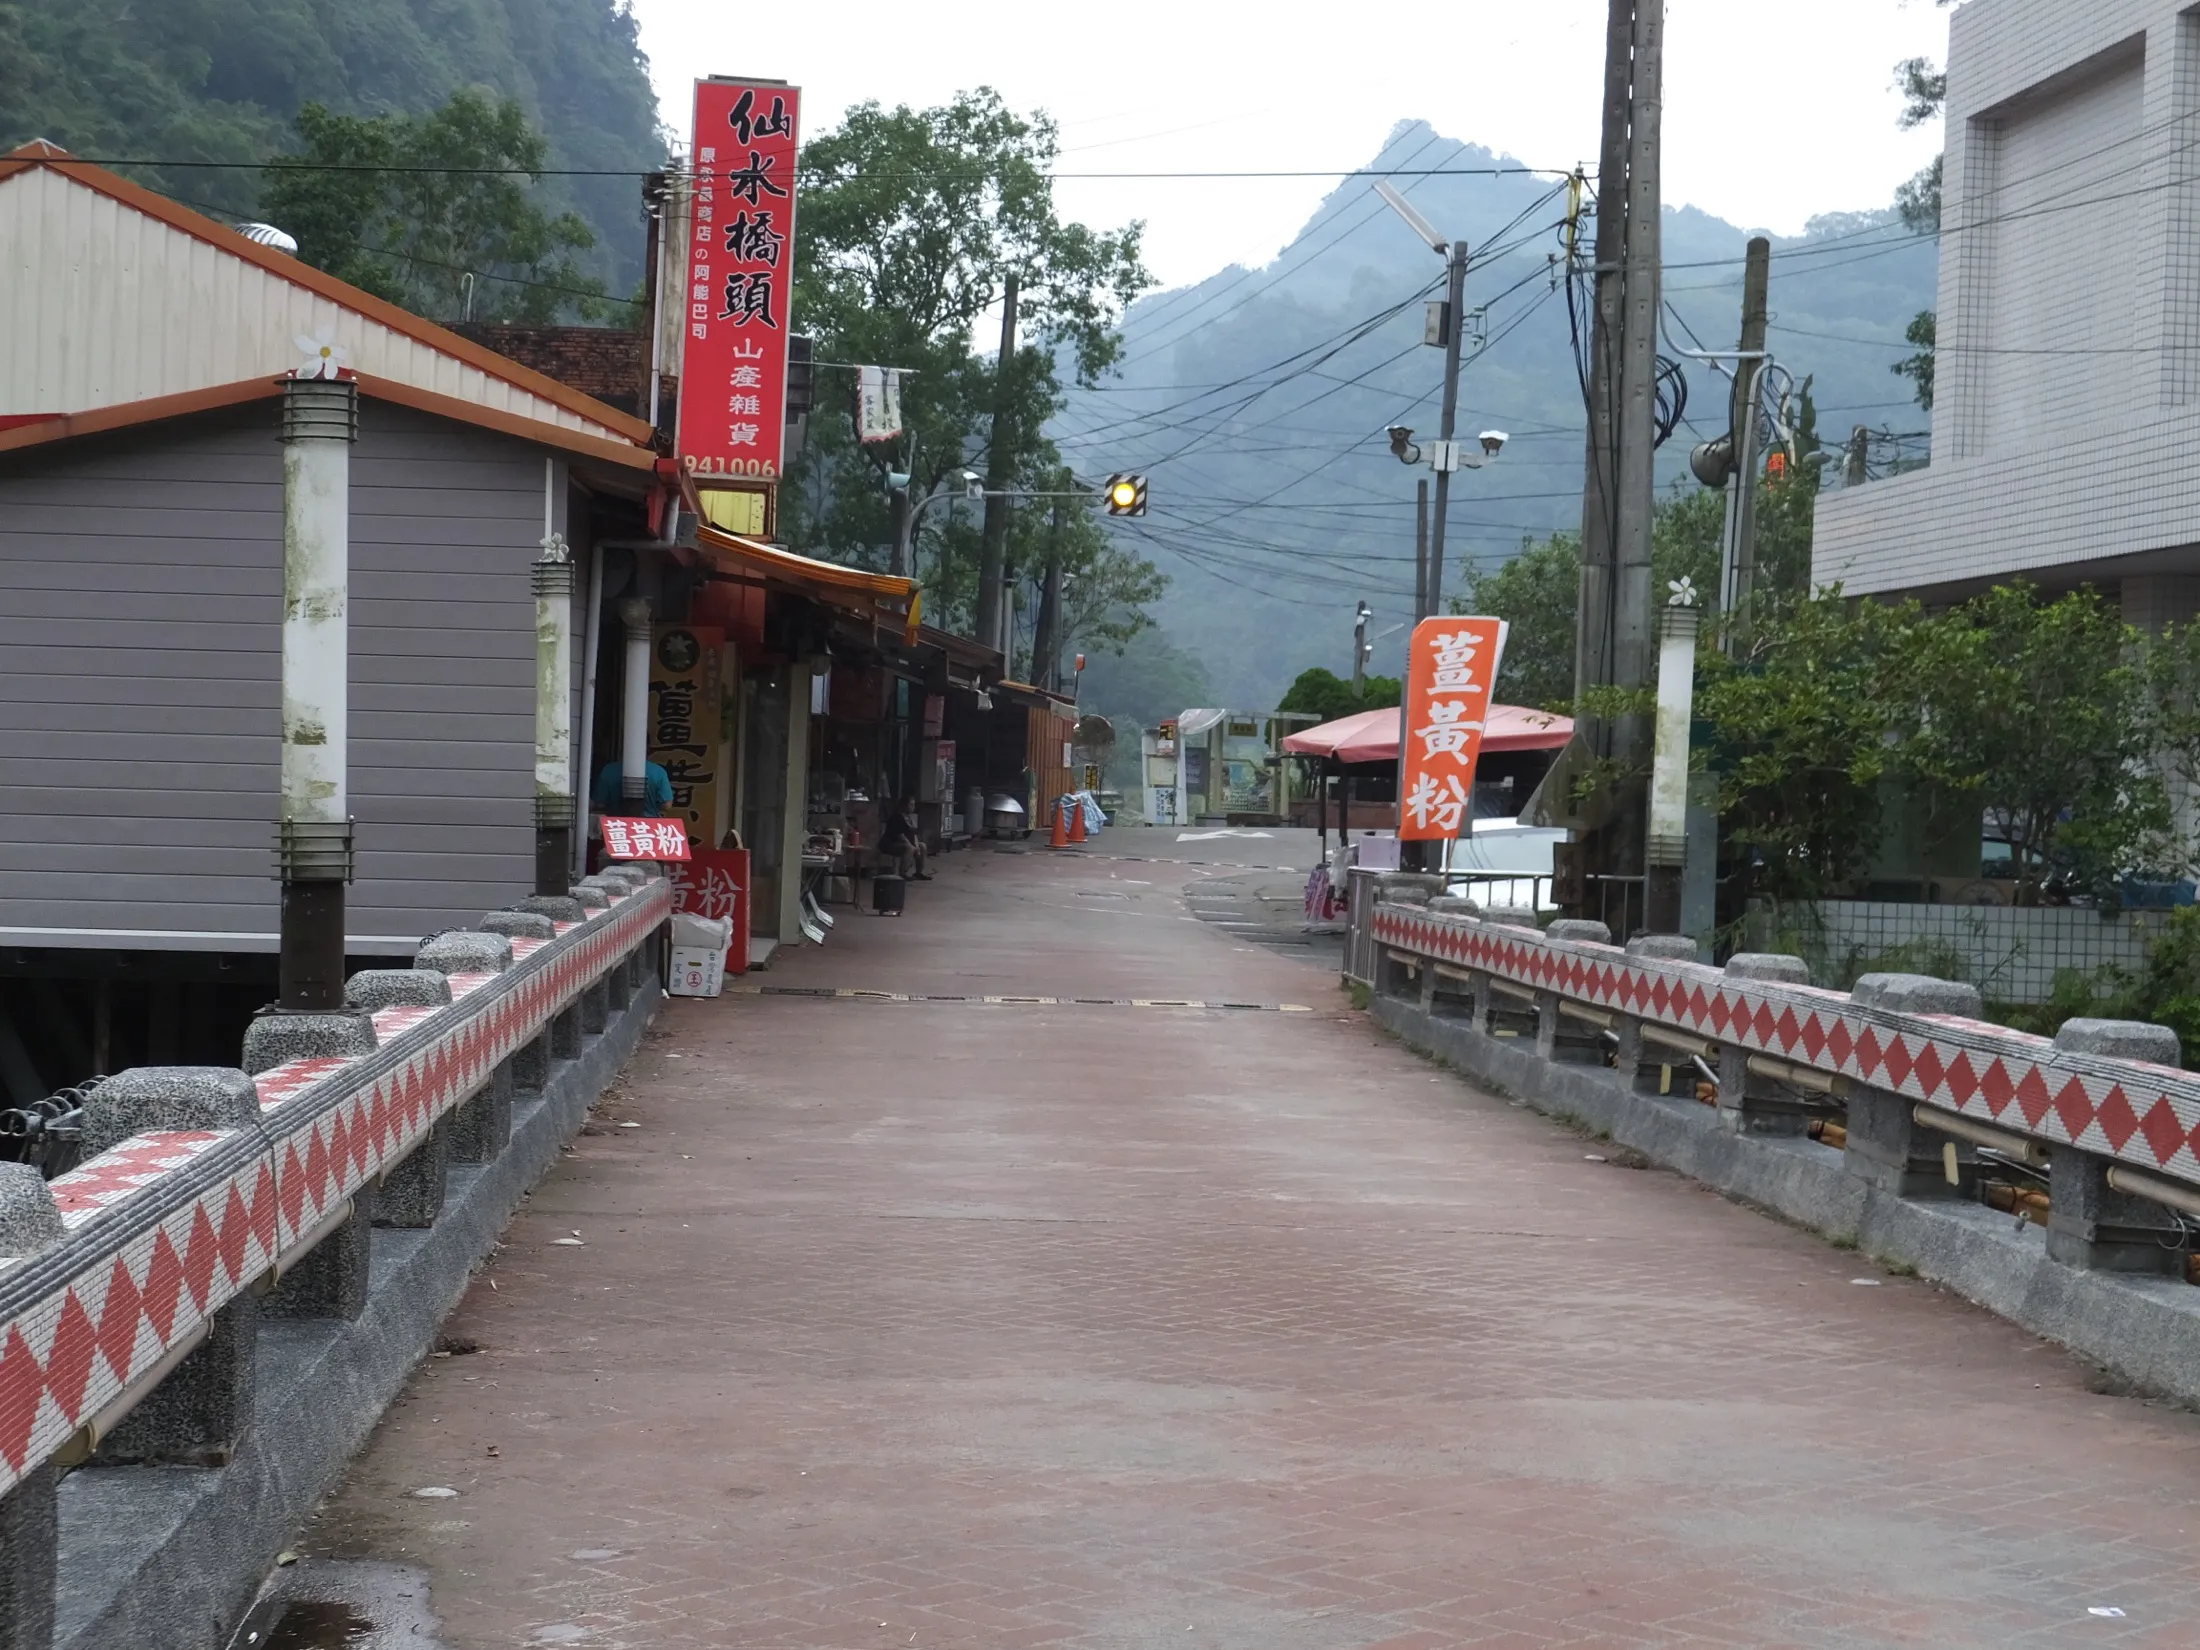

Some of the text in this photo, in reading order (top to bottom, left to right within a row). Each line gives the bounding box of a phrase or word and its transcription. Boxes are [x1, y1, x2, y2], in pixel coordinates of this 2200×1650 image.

[717, 90, 793, 329] 仙水橋頭
[728, 337, 764, 446] 山產雜貨
[684, 454, 776, 478] 941006
[1406, 630, 1484, 830] 薑黃粉
[604, 819, 685, 858] 薑黃粉
